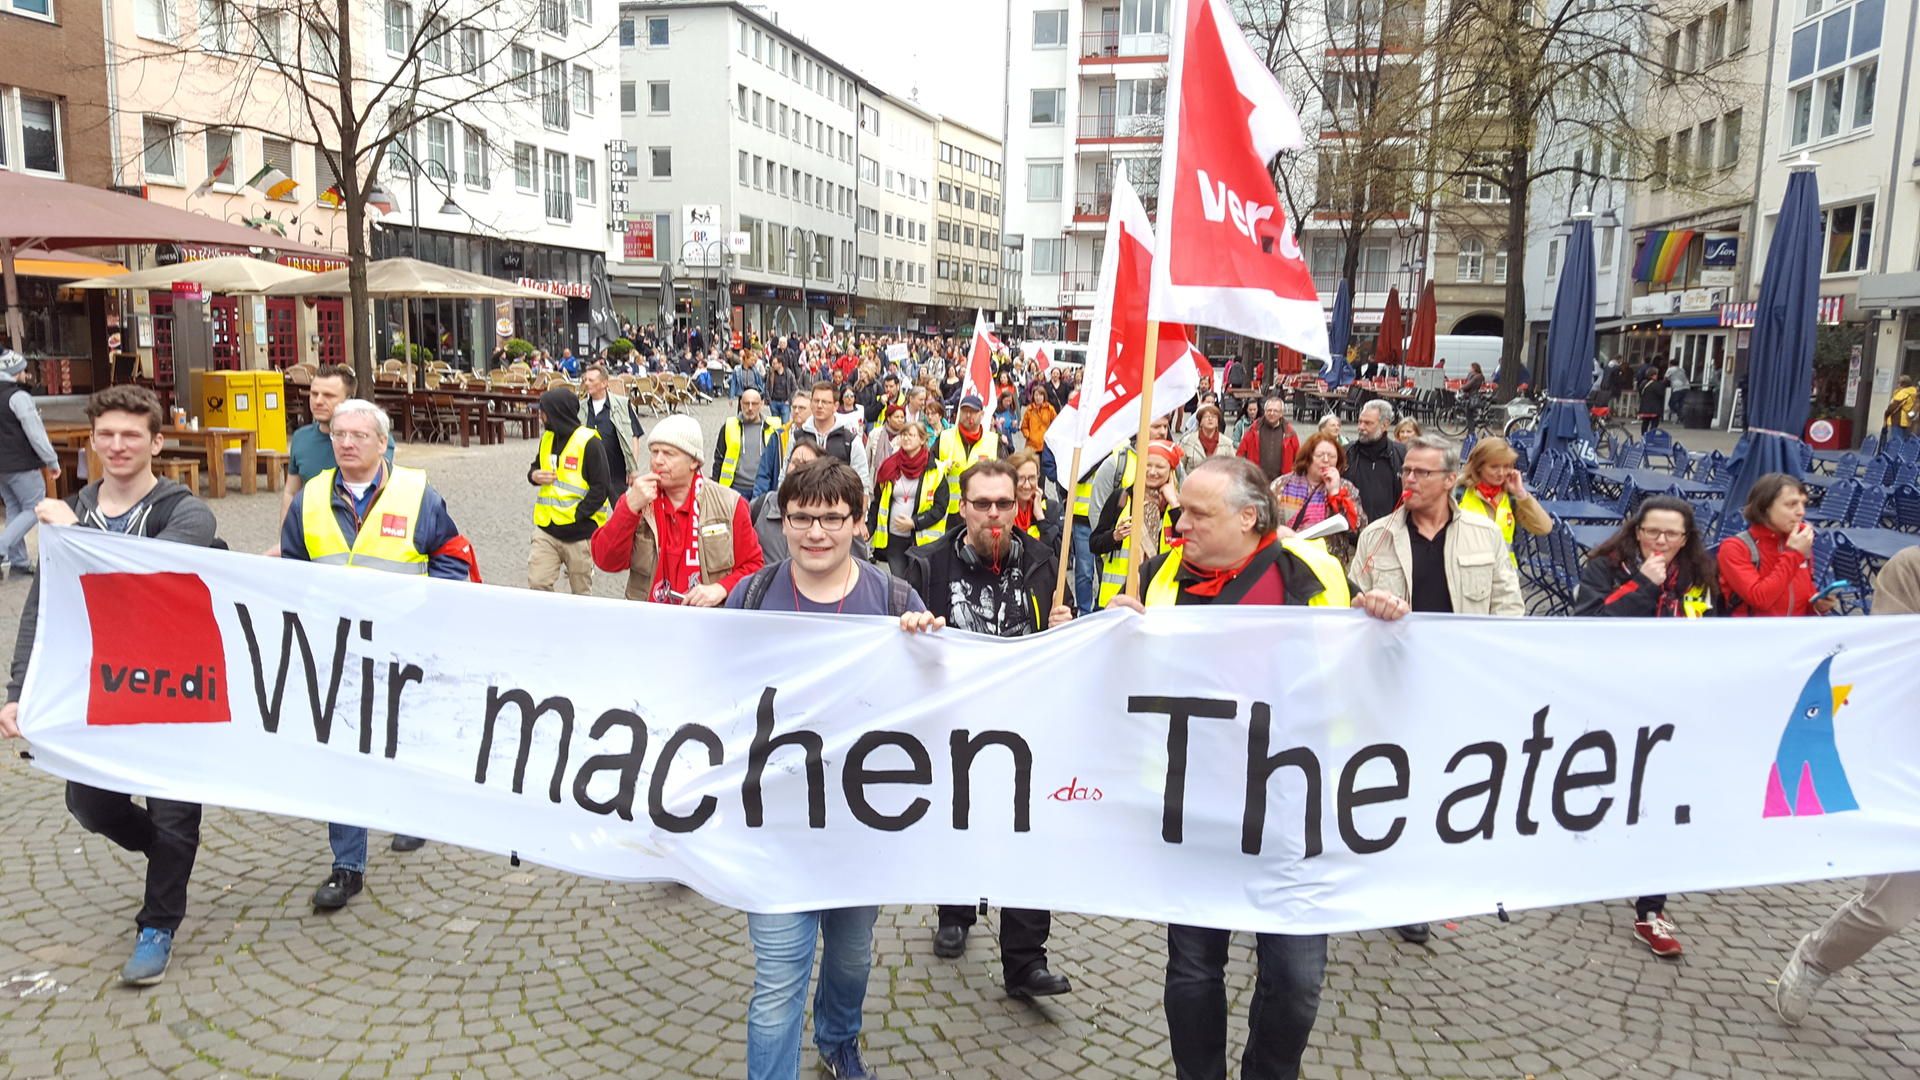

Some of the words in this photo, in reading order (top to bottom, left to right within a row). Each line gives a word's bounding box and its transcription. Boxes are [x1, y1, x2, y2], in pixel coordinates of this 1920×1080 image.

[287, 256, 320, 272] IRISH
[504, 255, 520, 267] sky
[101, 662, 217, 700] ver.di
[235, 602, 423, 760] Wir
[474, 686, 1033, 836] machen
[1047, 777, 1104, 803] das
